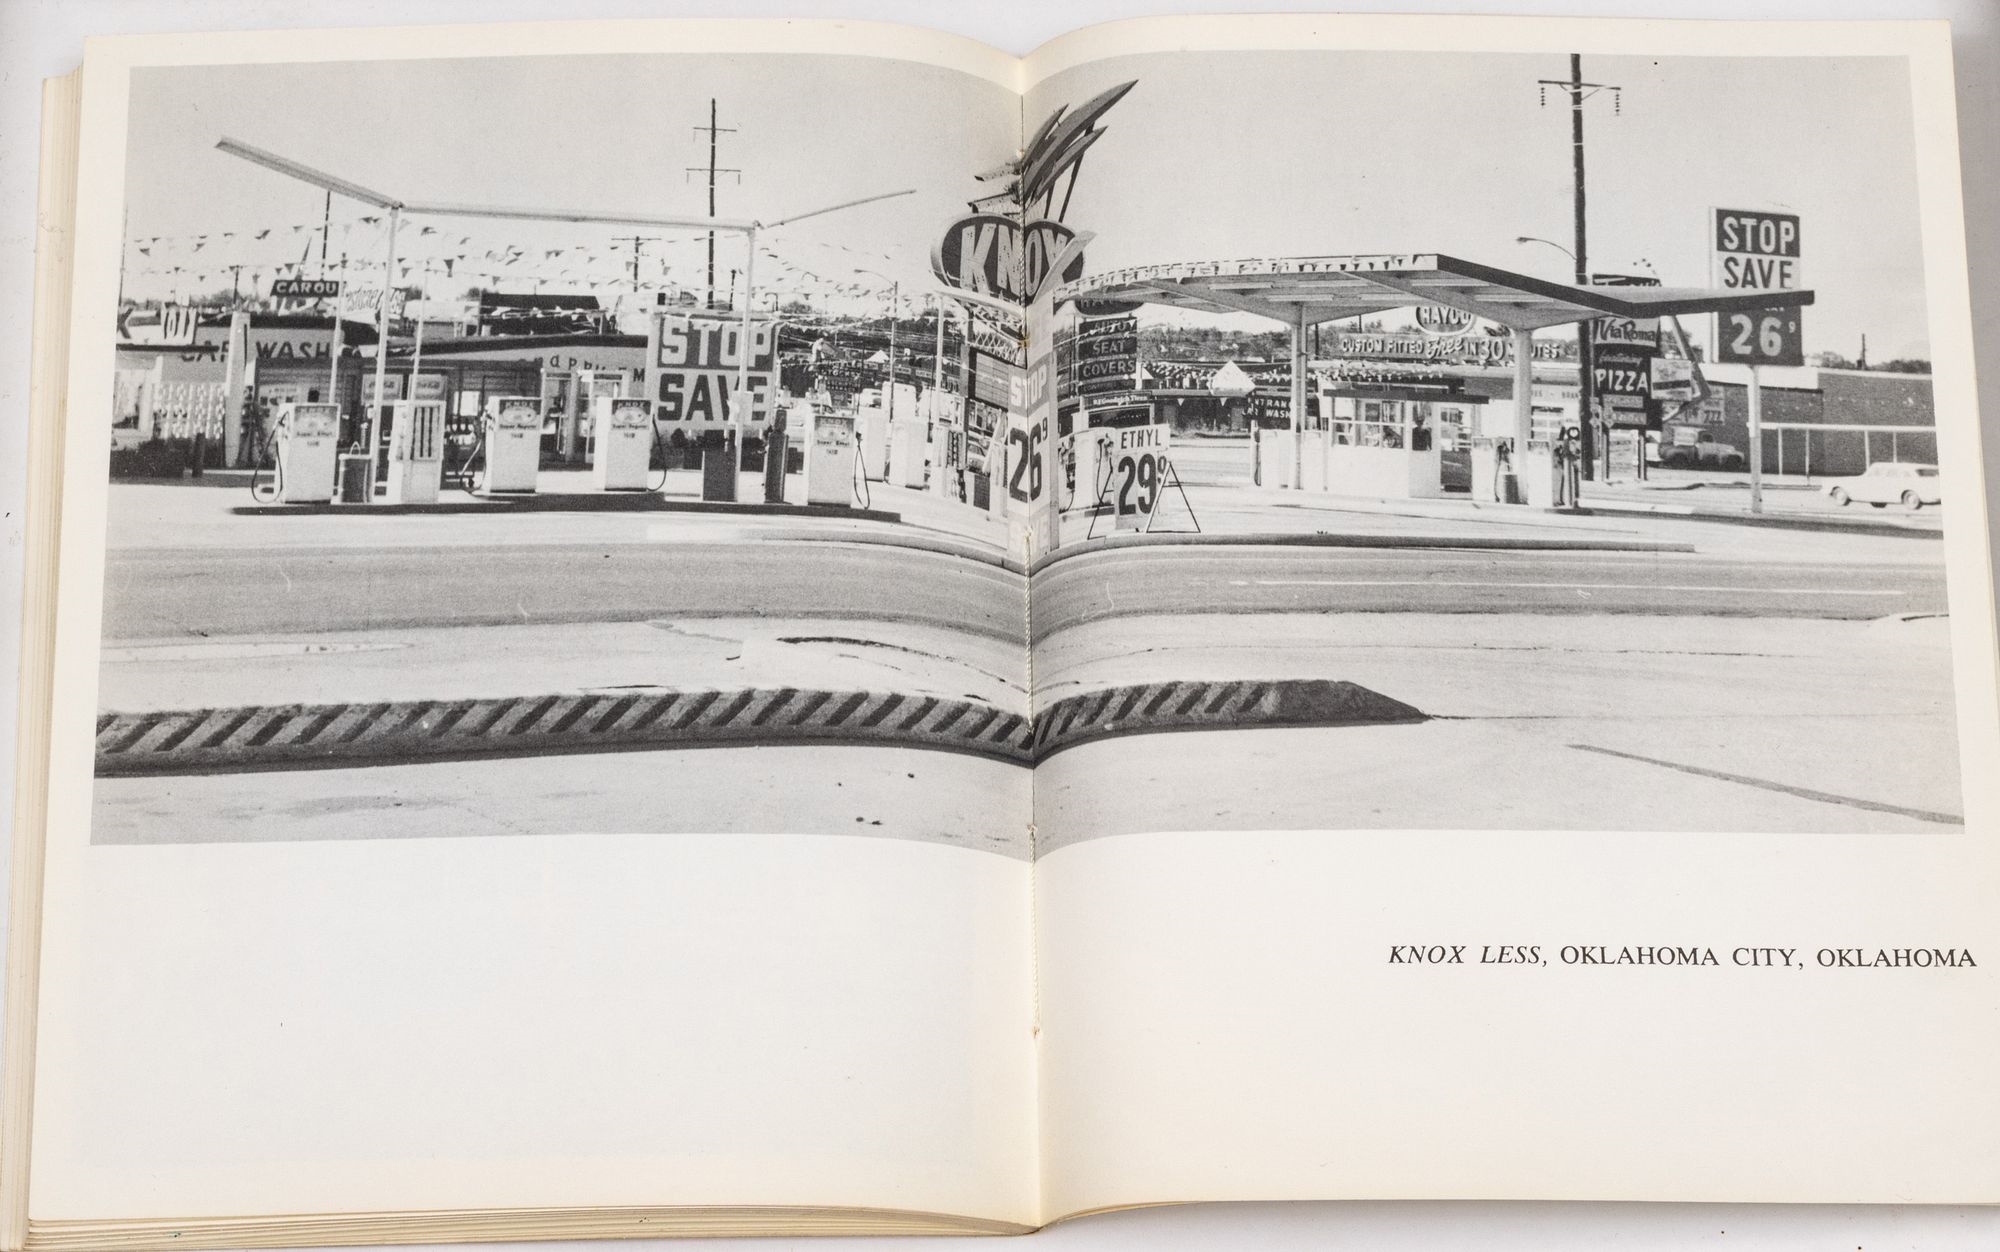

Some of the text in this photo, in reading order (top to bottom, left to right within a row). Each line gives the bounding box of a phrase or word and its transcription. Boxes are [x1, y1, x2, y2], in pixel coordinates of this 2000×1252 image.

[1723, 216, 1795, 255] STOP
[959, 222, 1070, 298] KNOX
[1724, 256, 1793, 289] SAVE
[256, 340, 331, 358] WASH
[660, 316, 771, 368] STOP
[1093, 340, 1126, 355] SEAT
[1341, 338, 1384, 355] CUSTOM
[1388, 340, 1424, 355] FITTED
[1480, 338, 1503, 361] 30
[1082, 360, 1136, 378] COVERS
[1594, 368, 1649, 393] PIZZA
[657, 372, 768, 421] SAVE
[1010, 363, 1048, 408] STOP
[1121, 428, 1162, 449] ETHYL
[1388, 944, 1978, 970] KNOX LESS, OKLAHOMA CITY, OKLAHOMA
